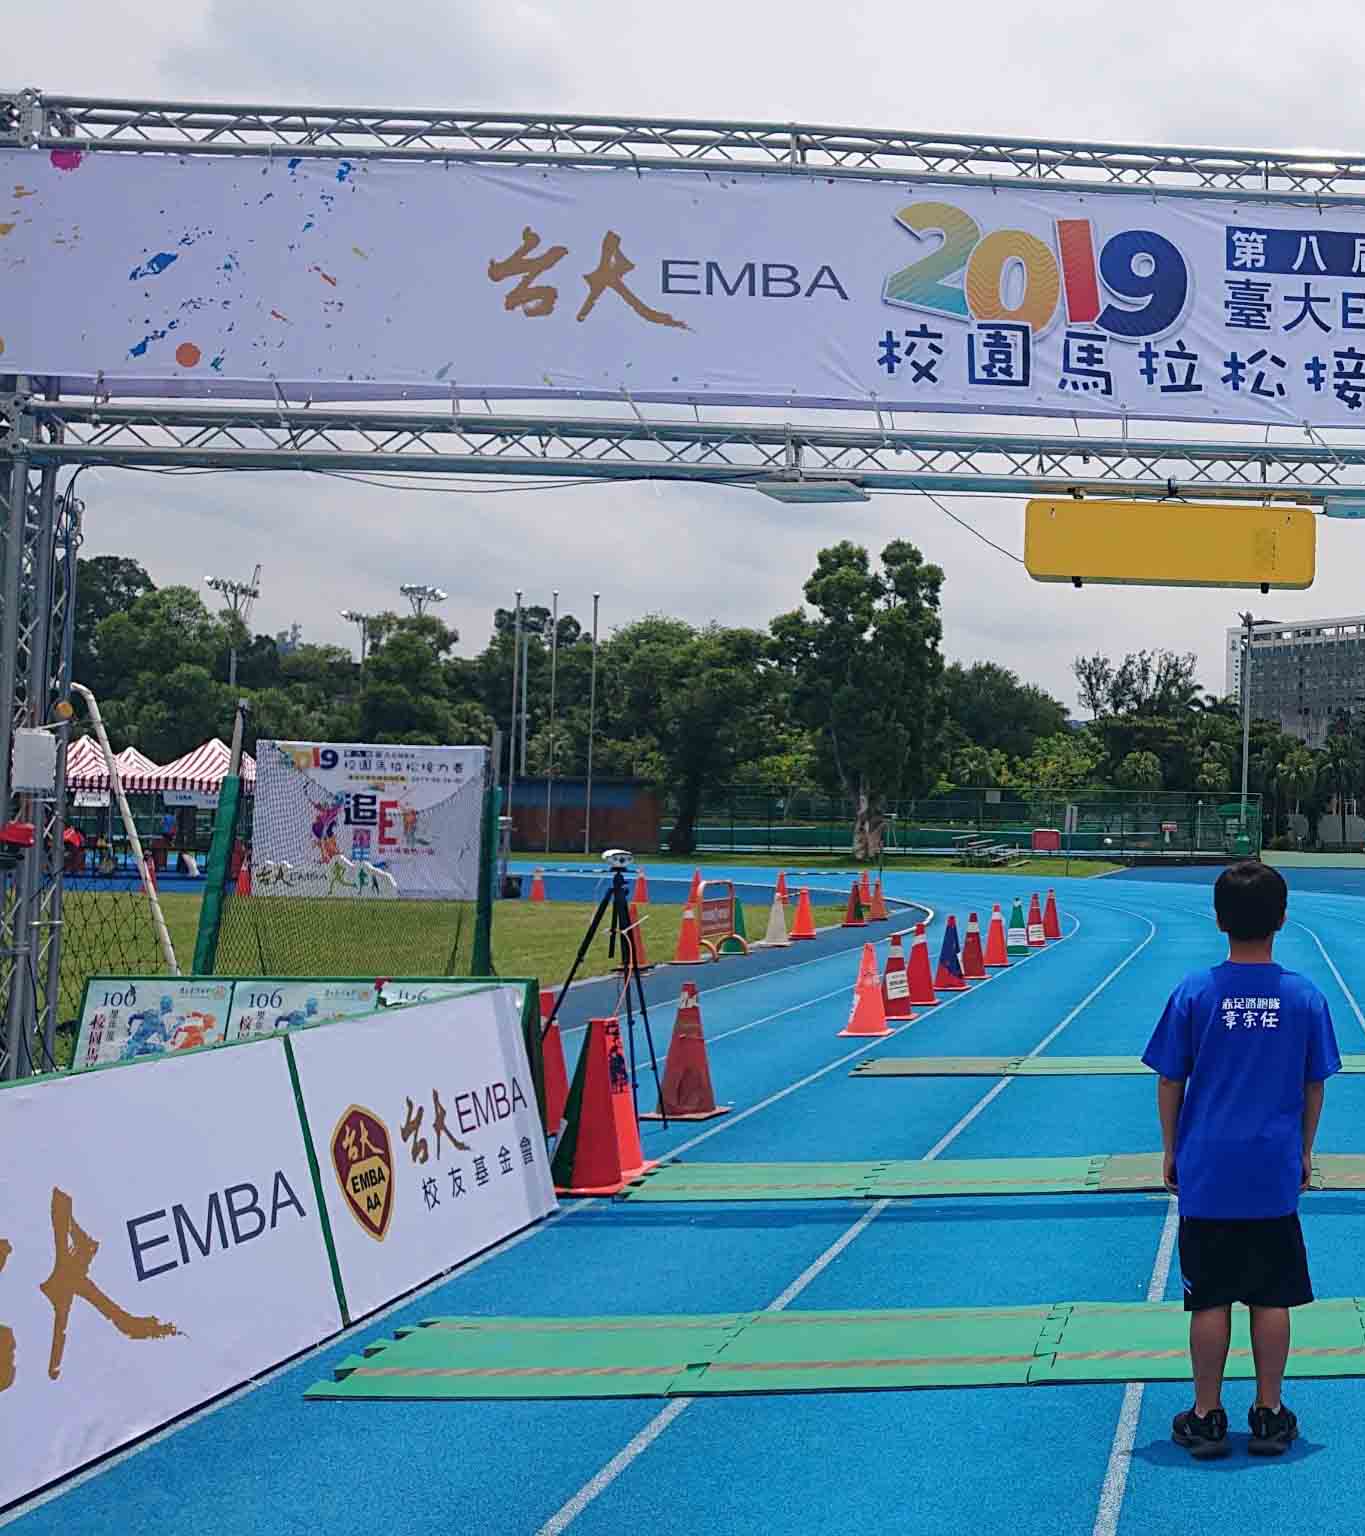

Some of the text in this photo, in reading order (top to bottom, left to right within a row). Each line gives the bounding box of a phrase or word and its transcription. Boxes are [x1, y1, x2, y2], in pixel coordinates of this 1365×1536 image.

[885, 201, 1188, 336] 2019
[247, 987, 285, 1008] 106
[1221, 1011, 1280, 1030] 章宗任
[351, 1167, 386, 1194] EMBA
[366, 1195, 382, 1213] AA
